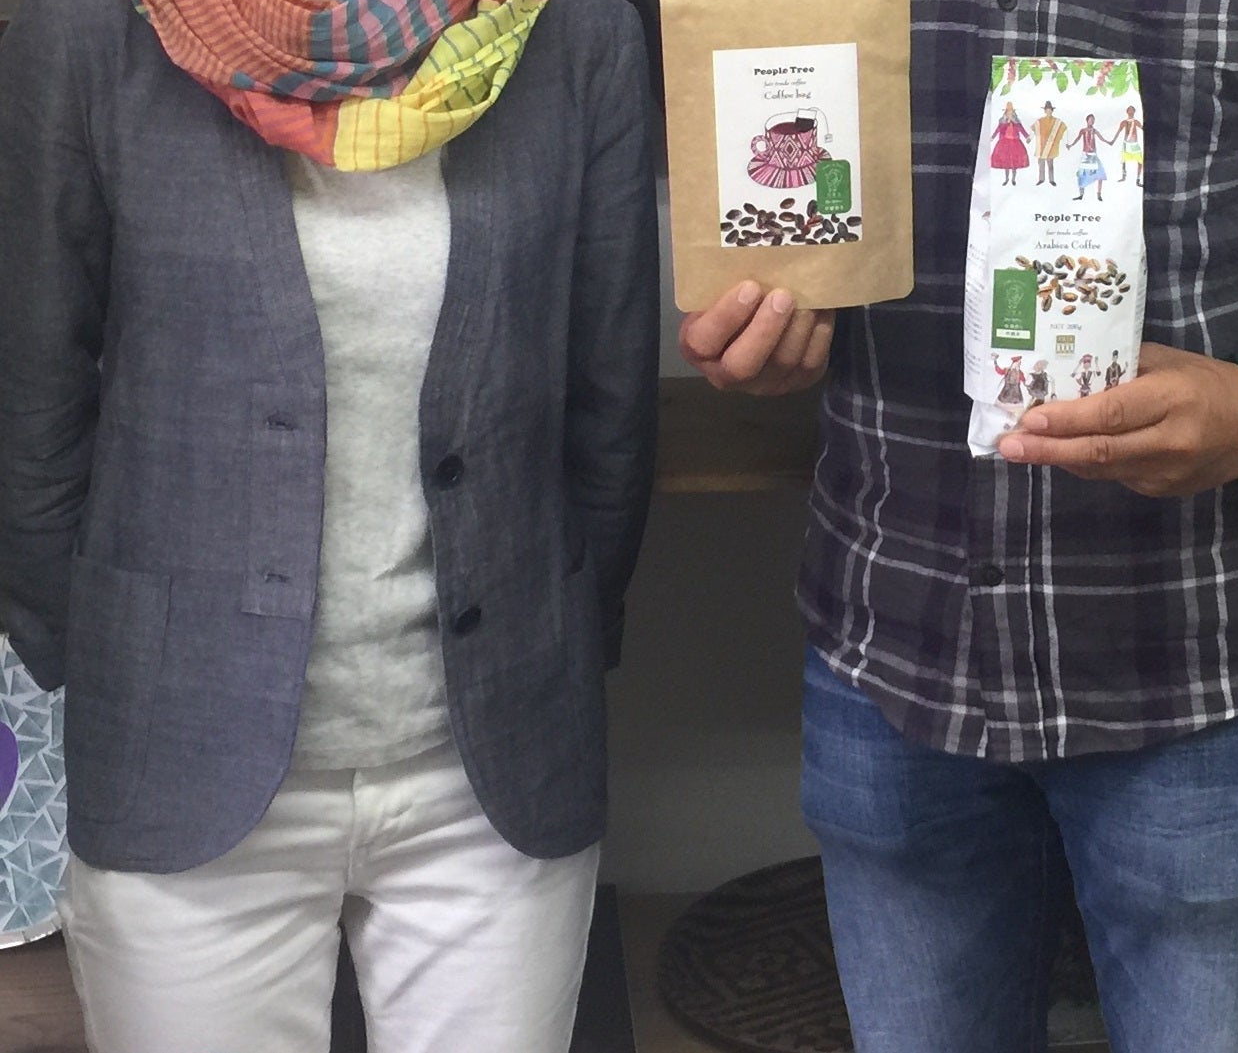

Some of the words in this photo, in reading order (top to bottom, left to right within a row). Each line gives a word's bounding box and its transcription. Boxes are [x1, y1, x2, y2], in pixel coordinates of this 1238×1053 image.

[754, 67, 788, 76] People
[789, 66, 815, 74] Tree
[763, 89, 794, 100] Coffee
[795, 88, 812, 99] bag
[1034, 213, 1071, 223] People
[1072, 213, 1102, 222] Tree
[1034, 238, 1069, 250] Arabica
[1071, 238, 1101, 250] Coffee
